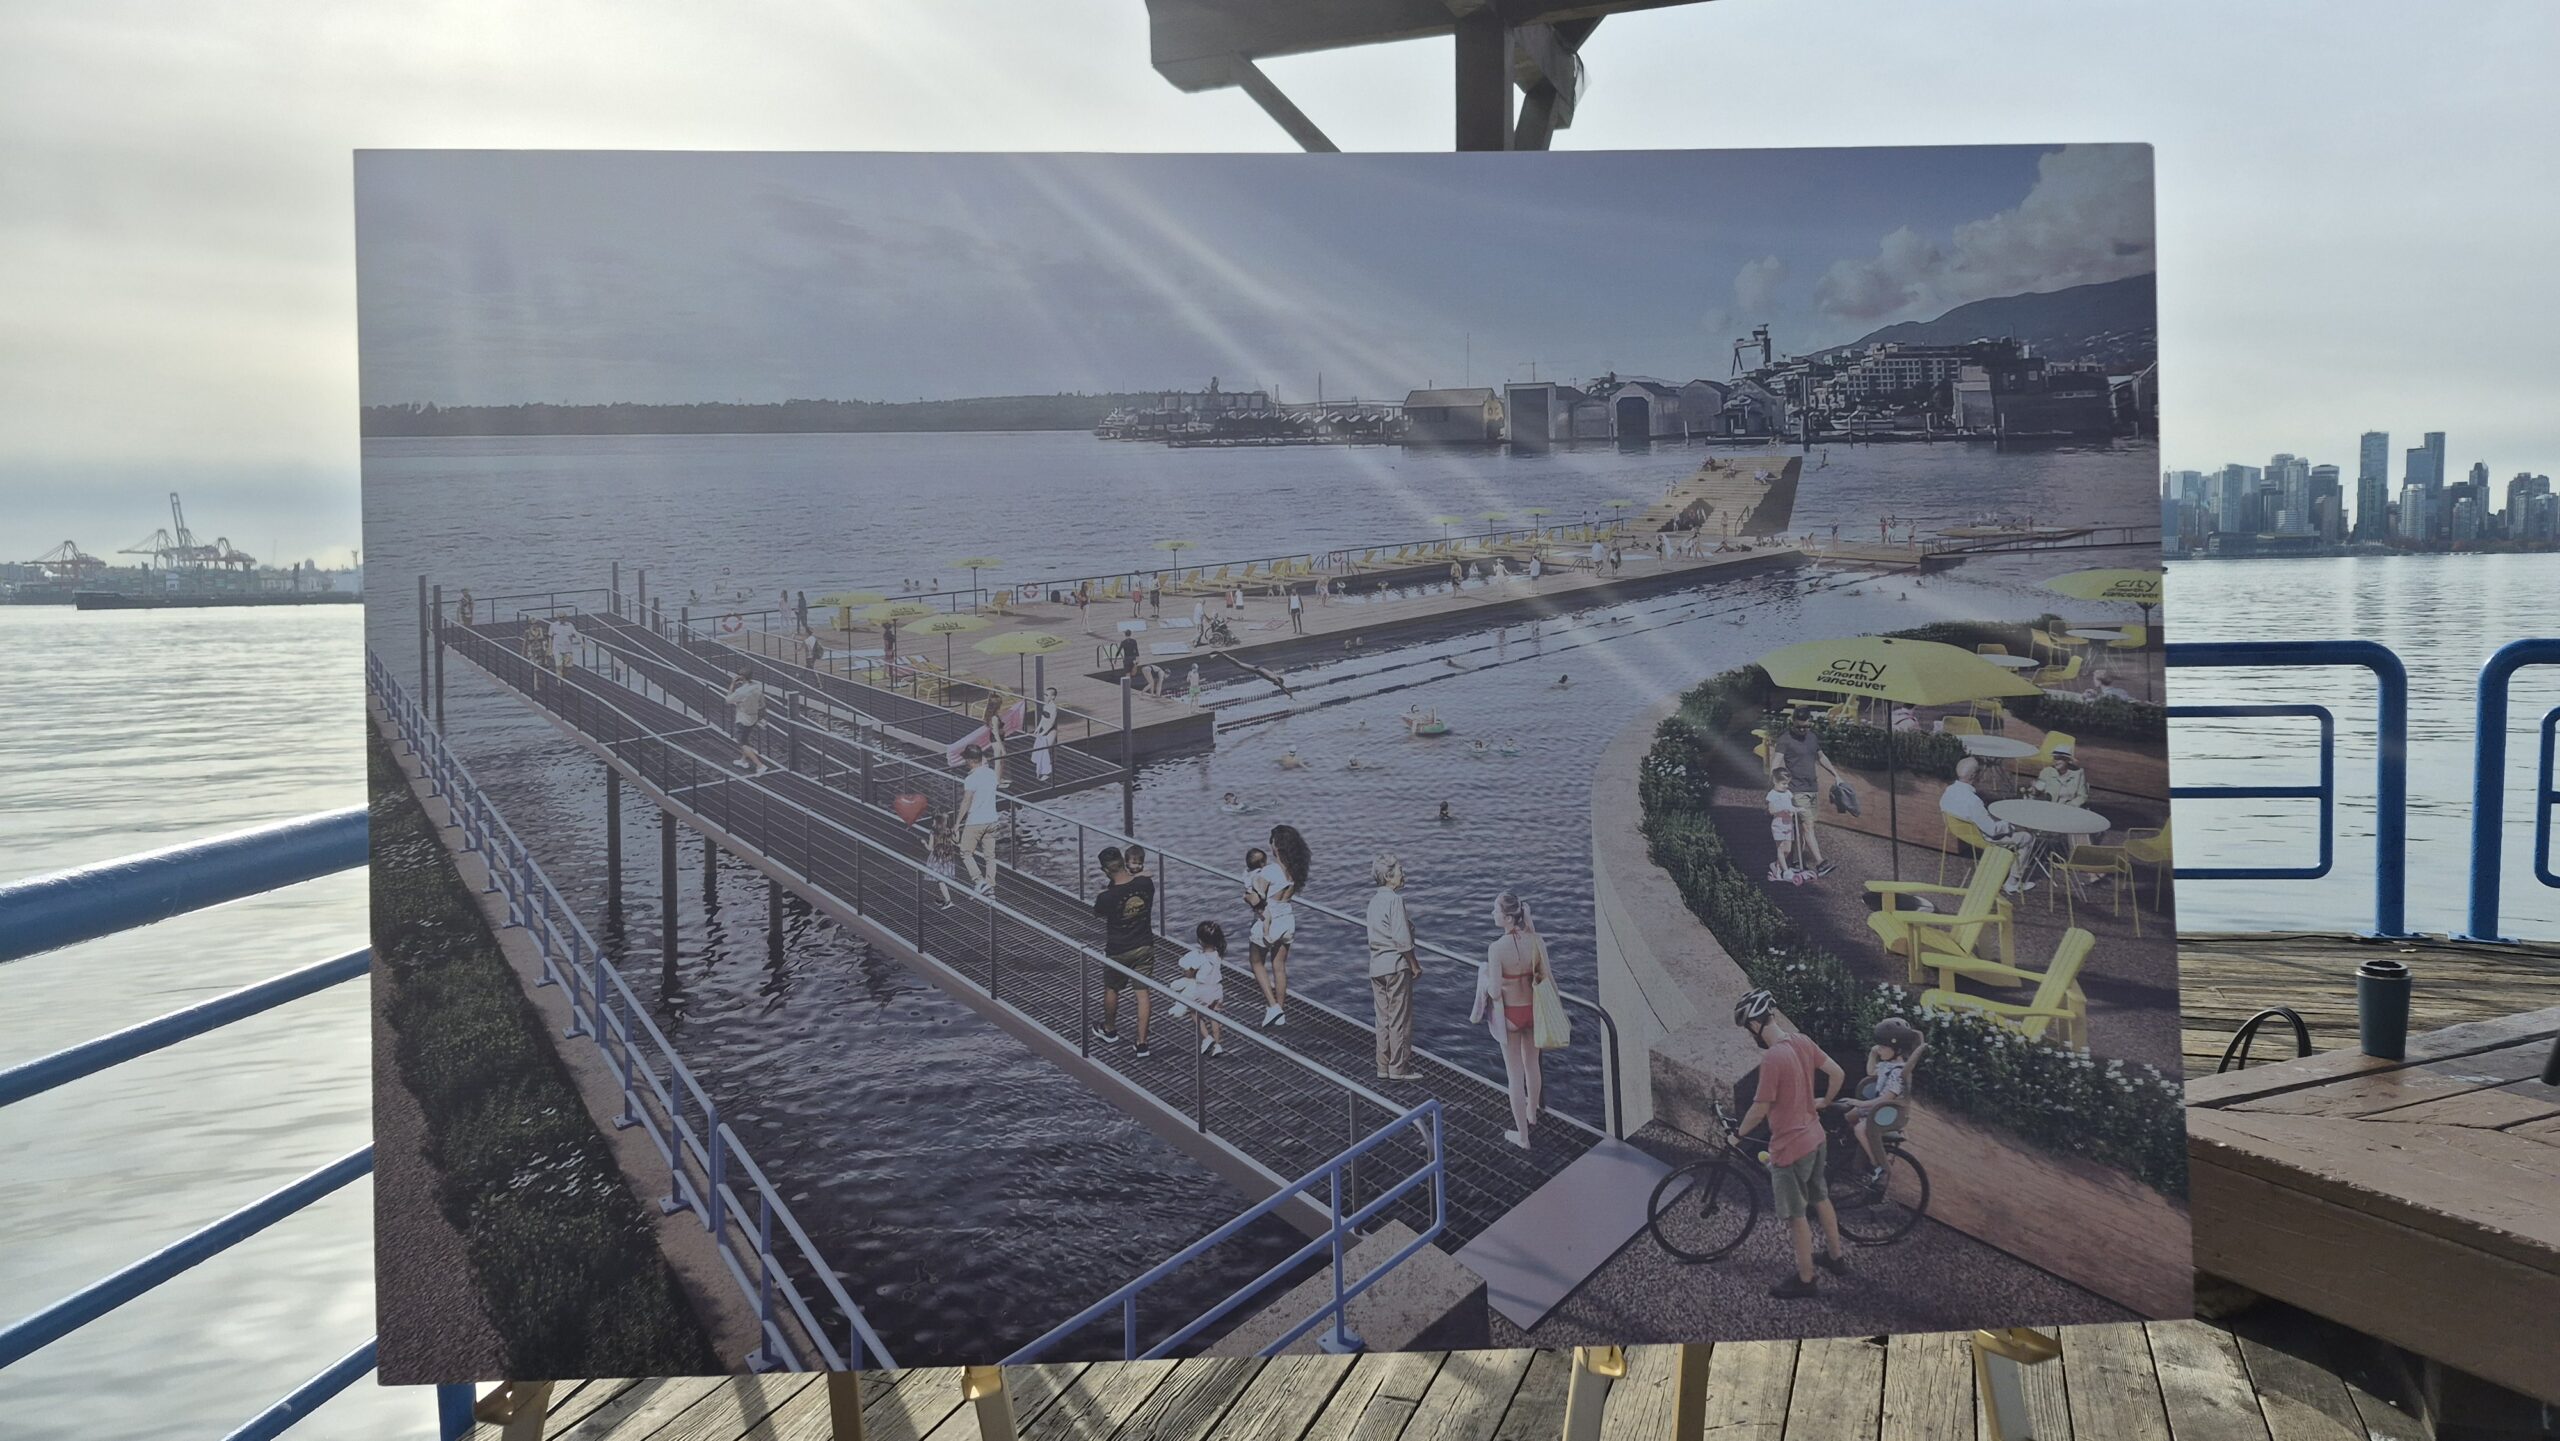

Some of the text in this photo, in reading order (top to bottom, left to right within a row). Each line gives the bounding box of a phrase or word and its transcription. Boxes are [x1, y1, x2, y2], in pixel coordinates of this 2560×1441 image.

[1831, 659, 1887, 681] city
[1834, 670, 1867, 681] north
[1816, 675, 1887, 691] vancouver
